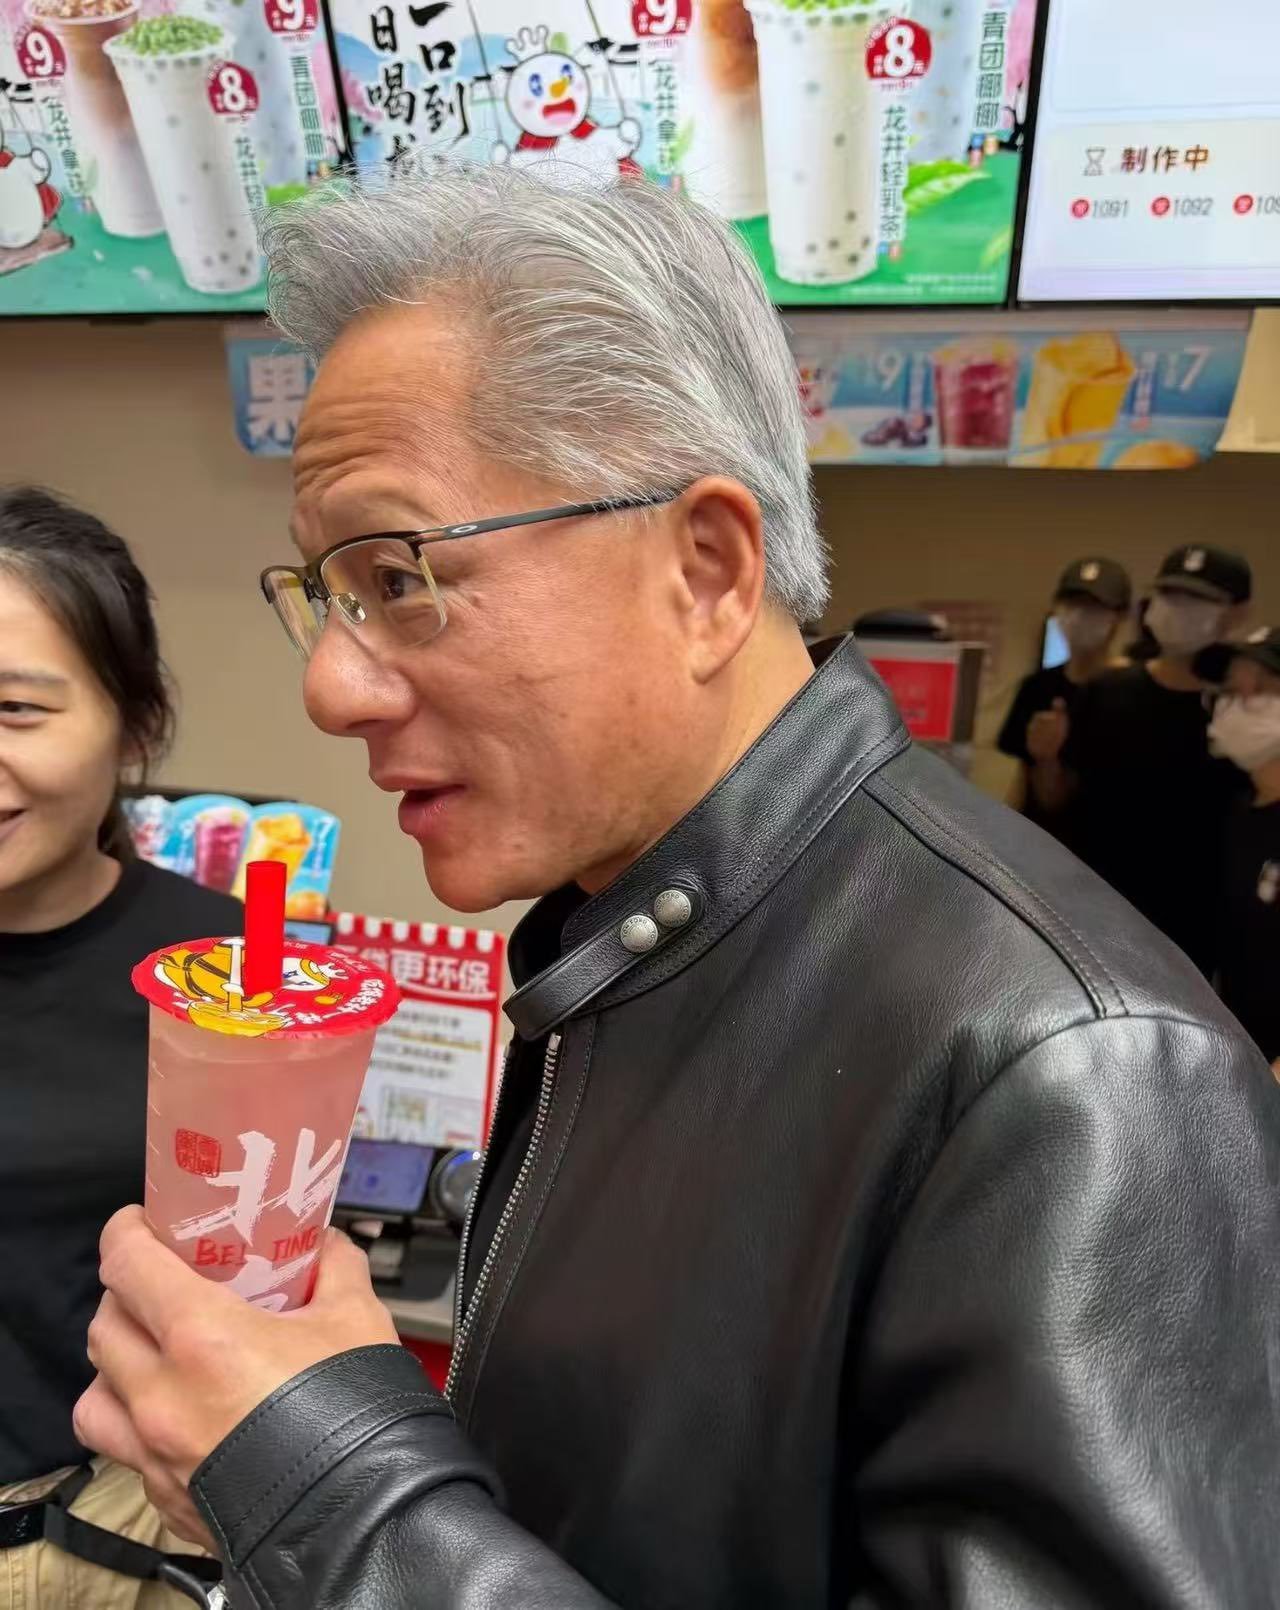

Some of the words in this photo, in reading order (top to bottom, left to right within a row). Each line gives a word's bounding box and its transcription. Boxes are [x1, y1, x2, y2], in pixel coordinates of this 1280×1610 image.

[276, 0, 305, 31] 9
[646, 0, 678, 35] 9
[26, 32, 53, 76] 9
[884, 24, 915, 77] 8
[219, 66, 247, 112] 8
[1121, 145, 1209, 173] 制作中
[1092, 199, 1128, 218] 1091
[1173, 197, 1213, 216] 1092
[195, 1237, 247, 1265] BEI
